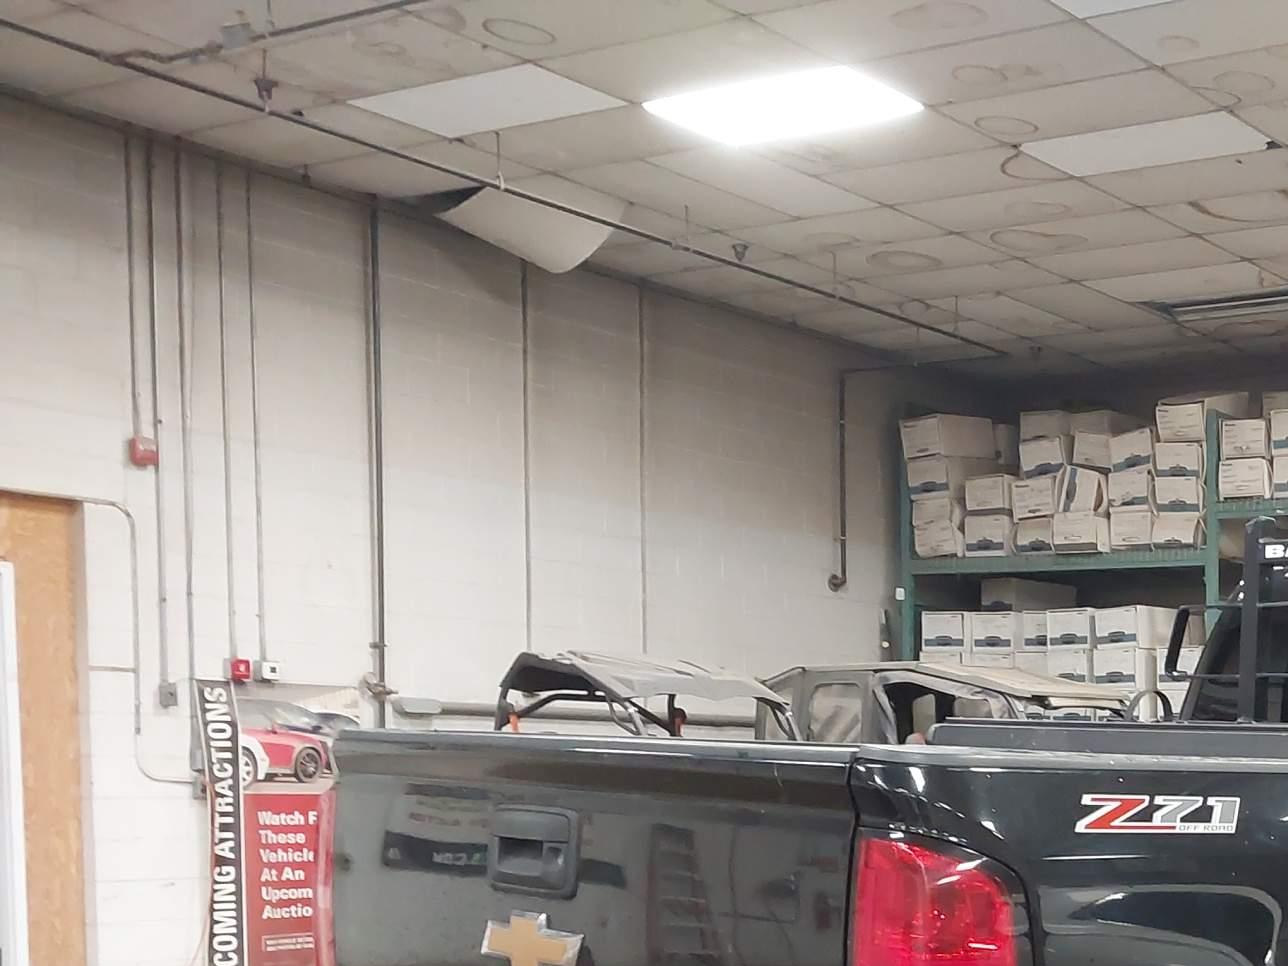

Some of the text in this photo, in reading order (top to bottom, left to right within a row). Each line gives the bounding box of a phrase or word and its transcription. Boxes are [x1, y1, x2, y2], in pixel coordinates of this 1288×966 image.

[203, 686, 236, 860] ATTRACTIONS
[257, 810, 305, 826] Watch
[1074, 793, 1241, 834] Z71
[258, 830, 306, 844] These
[260, 866, 305, 882] At An
